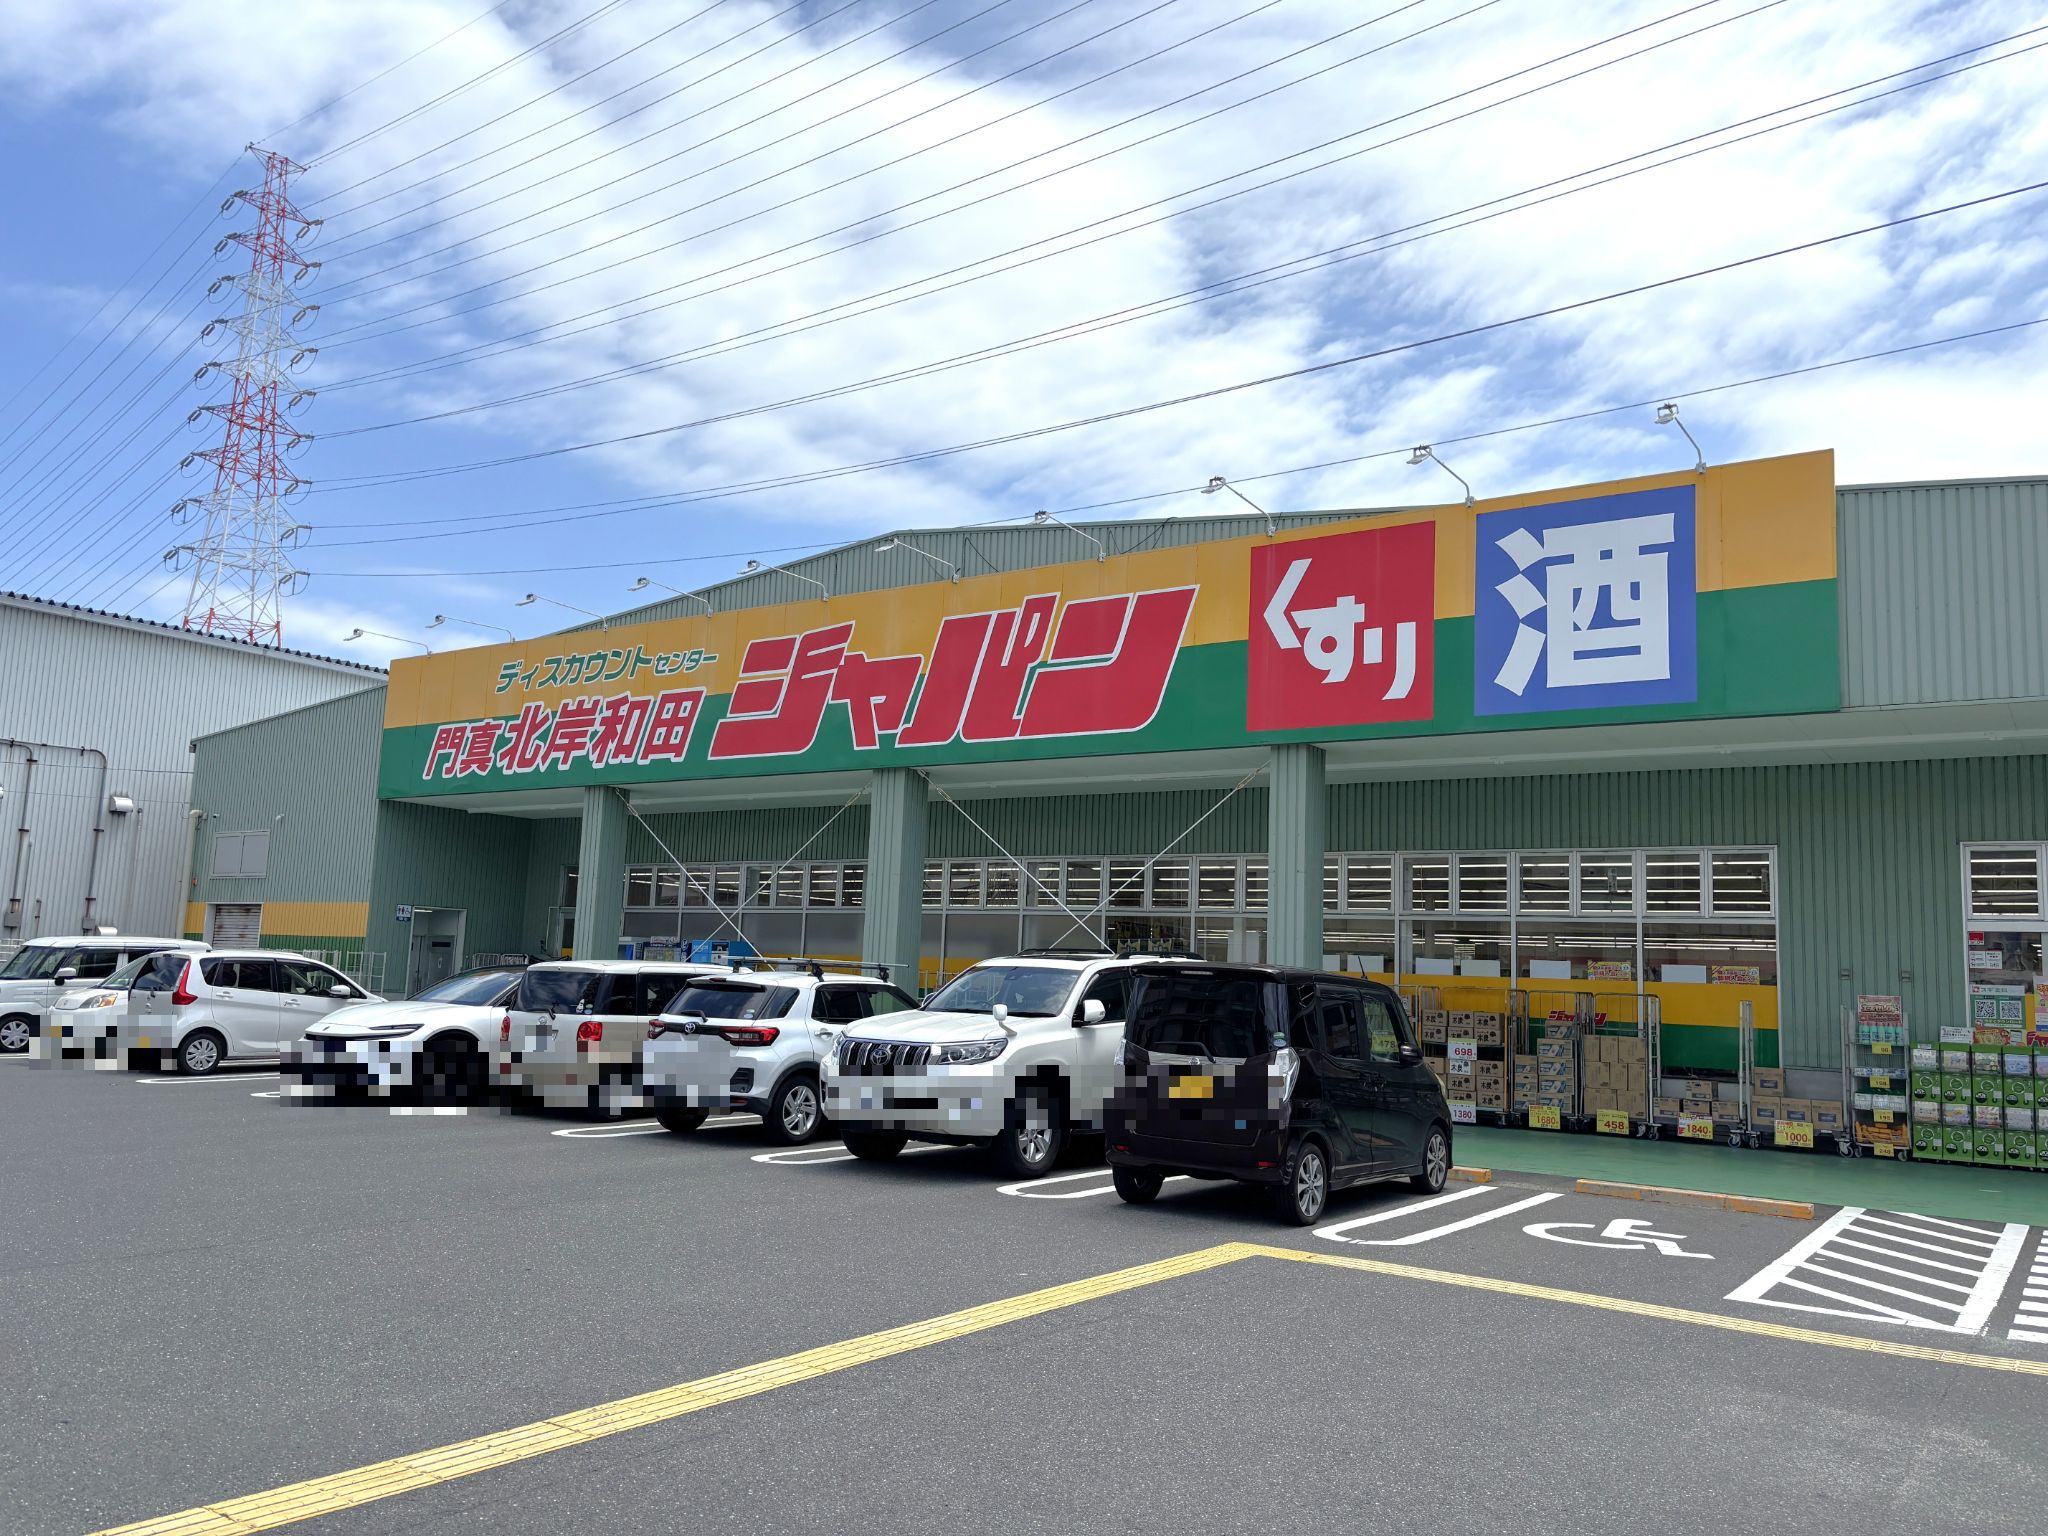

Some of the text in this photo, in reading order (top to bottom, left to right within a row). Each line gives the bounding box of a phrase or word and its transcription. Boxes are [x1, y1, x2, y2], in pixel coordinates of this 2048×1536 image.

[1493, 512, 1676, 697] 酒
[1263, 557, 1417, 701] くすり
[497, 644, 719, 695] ディスカウントセンター
[707, 584, 1202, 762] ジャパン
[421, 686, 707, 781] 門真北岸和田
[1454, 1047, 1473, 1056] 698
[1453, 1109, 1472, 1119] 1380
[1536, 1115, 1556, 1125] 1680
[1604, 1120, 1625, 1130] 458
[1686, 1123, 1709, 1134] 1840
[1784, 1131, 1808, 1143] 1000
